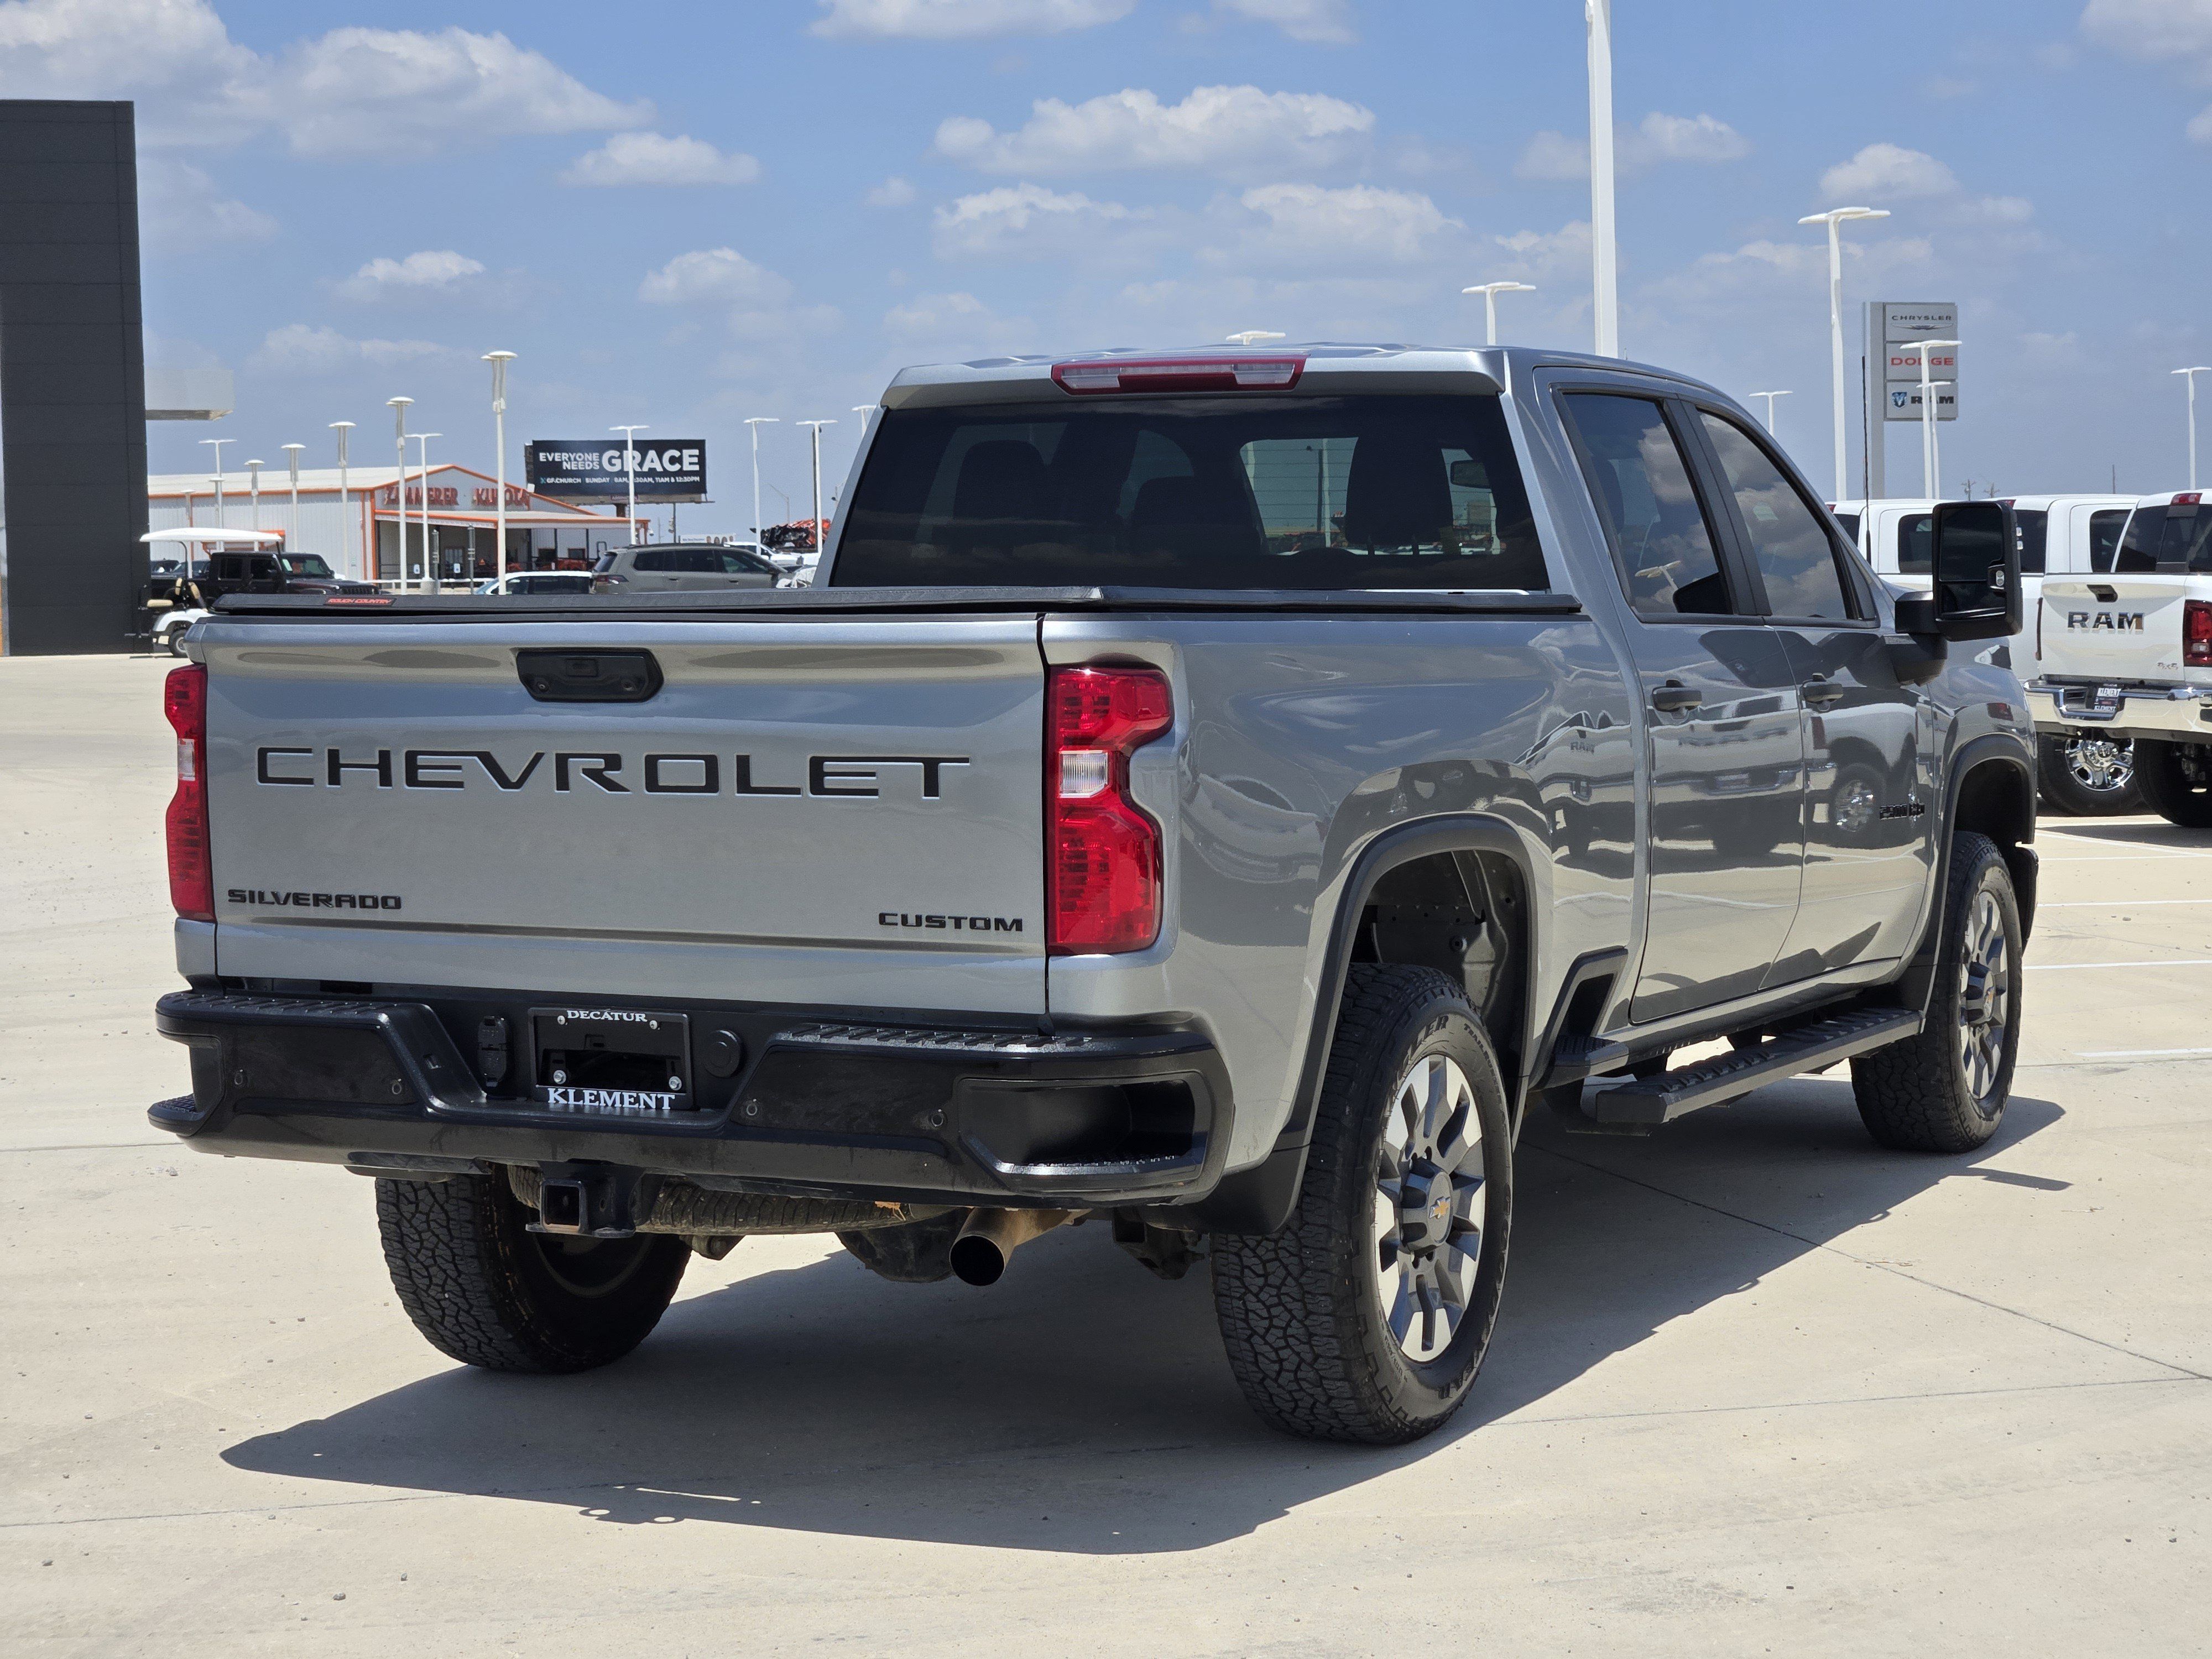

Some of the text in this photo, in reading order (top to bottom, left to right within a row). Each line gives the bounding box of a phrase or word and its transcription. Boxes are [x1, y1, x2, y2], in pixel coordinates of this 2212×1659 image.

[1911, 396, 1954, 404] RM
[539, 452, 600, 462] EVERYONE
[562, 461, 600, 470] NEEDS
[602, 449, 700, 472] GRACE
[2068, 611, 2145, 632] RAM
[257, 747, 970, 799] CHEVROLET
[228, 889, 401, 910] SILVERADO
[879, 912, 1022, 932] CUSTOM
[566, 1010, 648, 1022] DECATUR
[547, 1087, 675, 1110] KLEMENT
